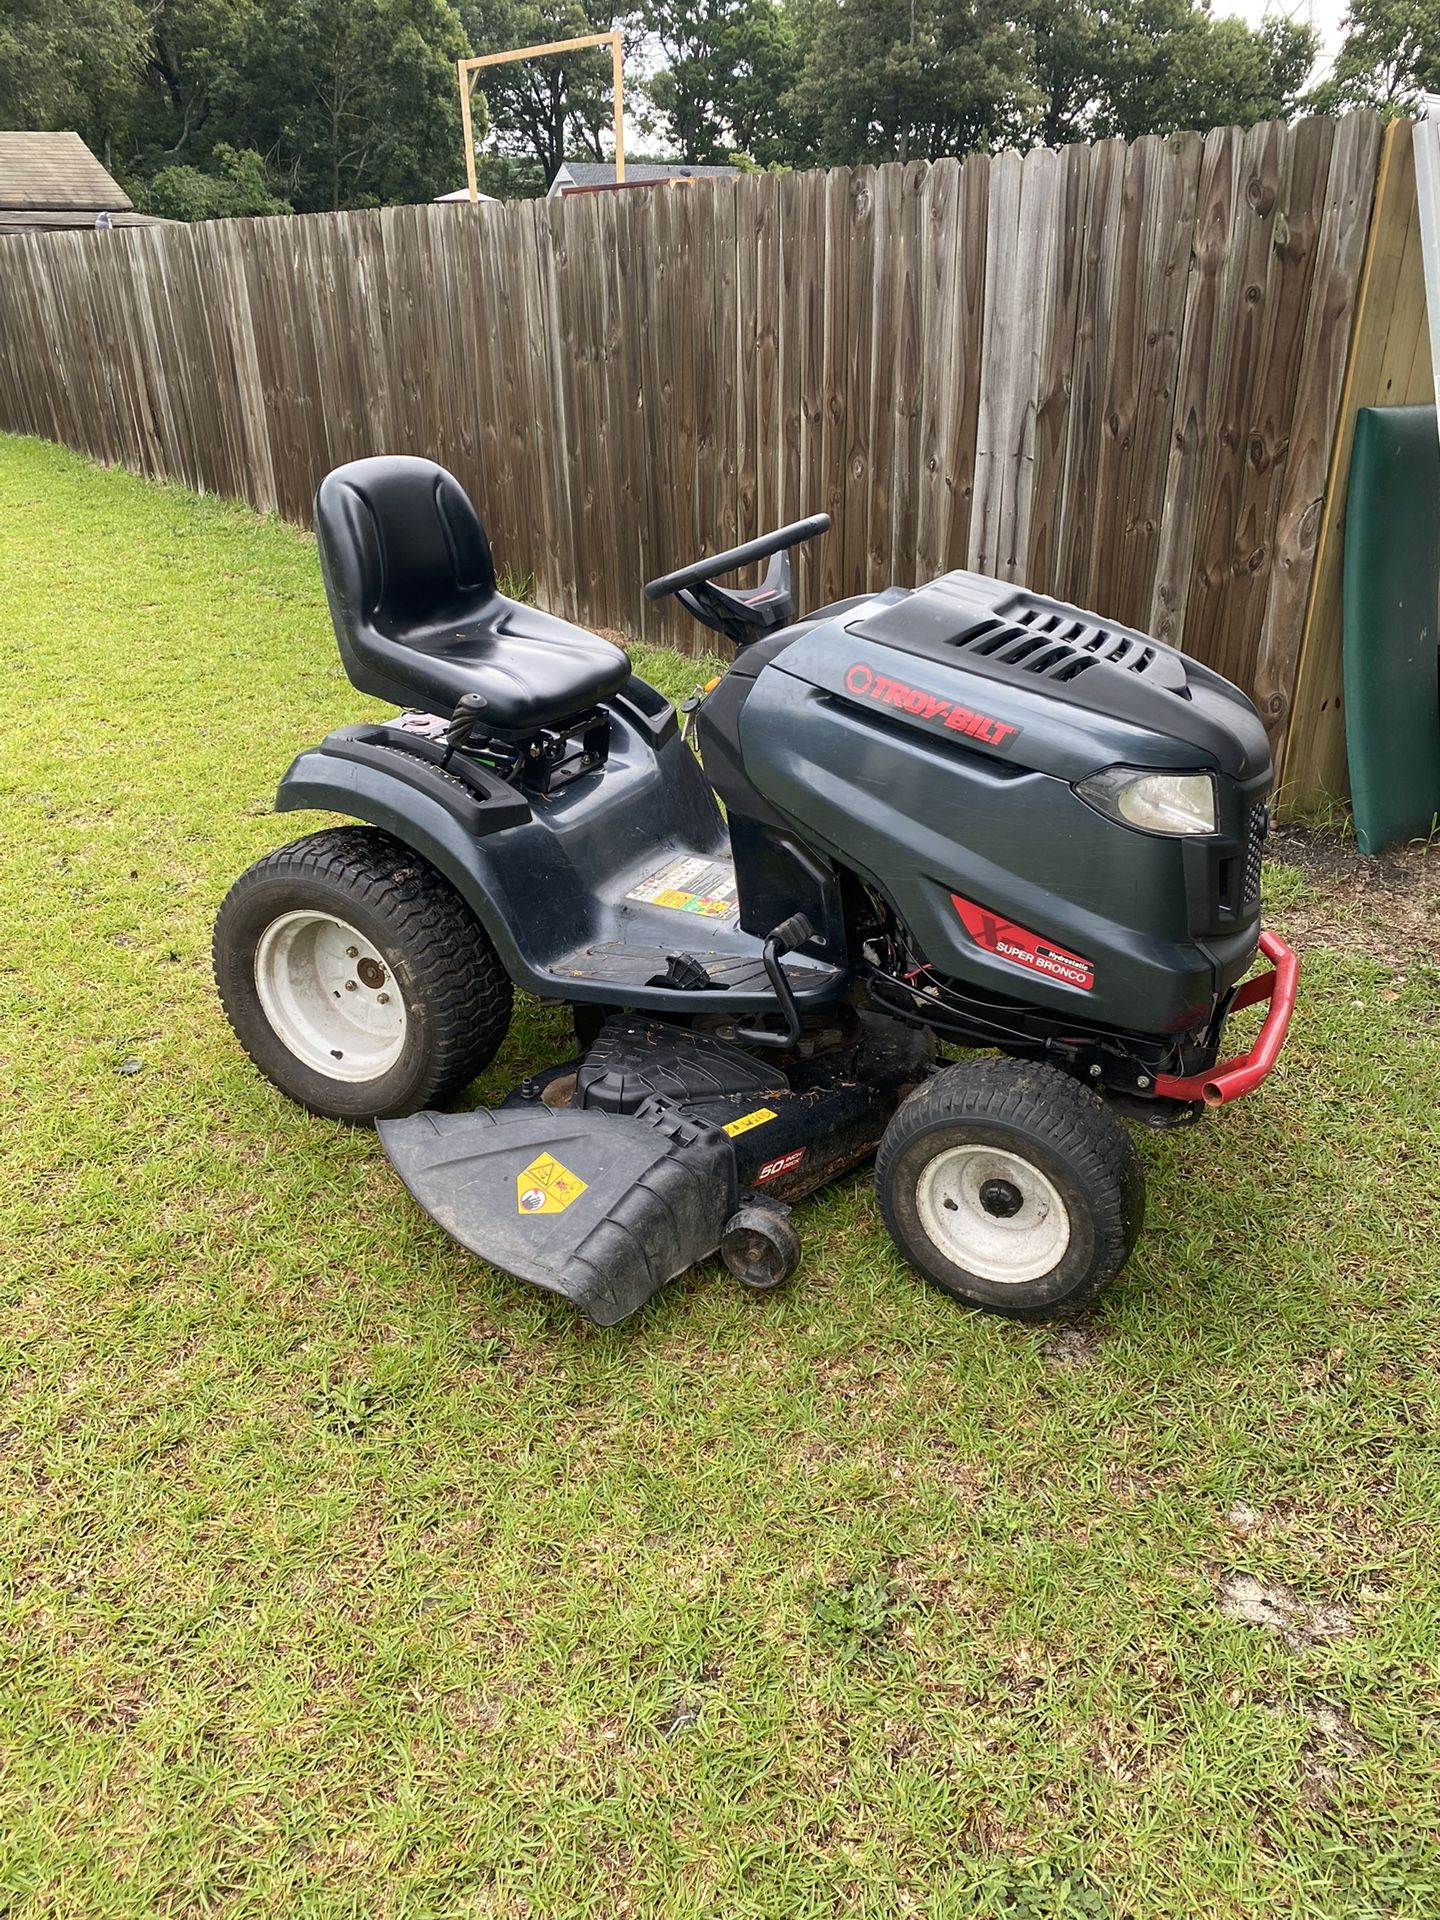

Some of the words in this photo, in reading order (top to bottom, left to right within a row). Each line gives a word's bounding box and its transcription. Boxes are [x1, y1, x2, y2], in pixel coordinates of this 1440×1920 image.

[870, 674, 1015, 745] TROY-BILT
[996, 941, 1035, 963] SUPER
[1035, 957, 1087, 983] BRONCO
[1048, 951, 1089, 972] Hydrostatic
[759, 1159, 785, 1180] 50
